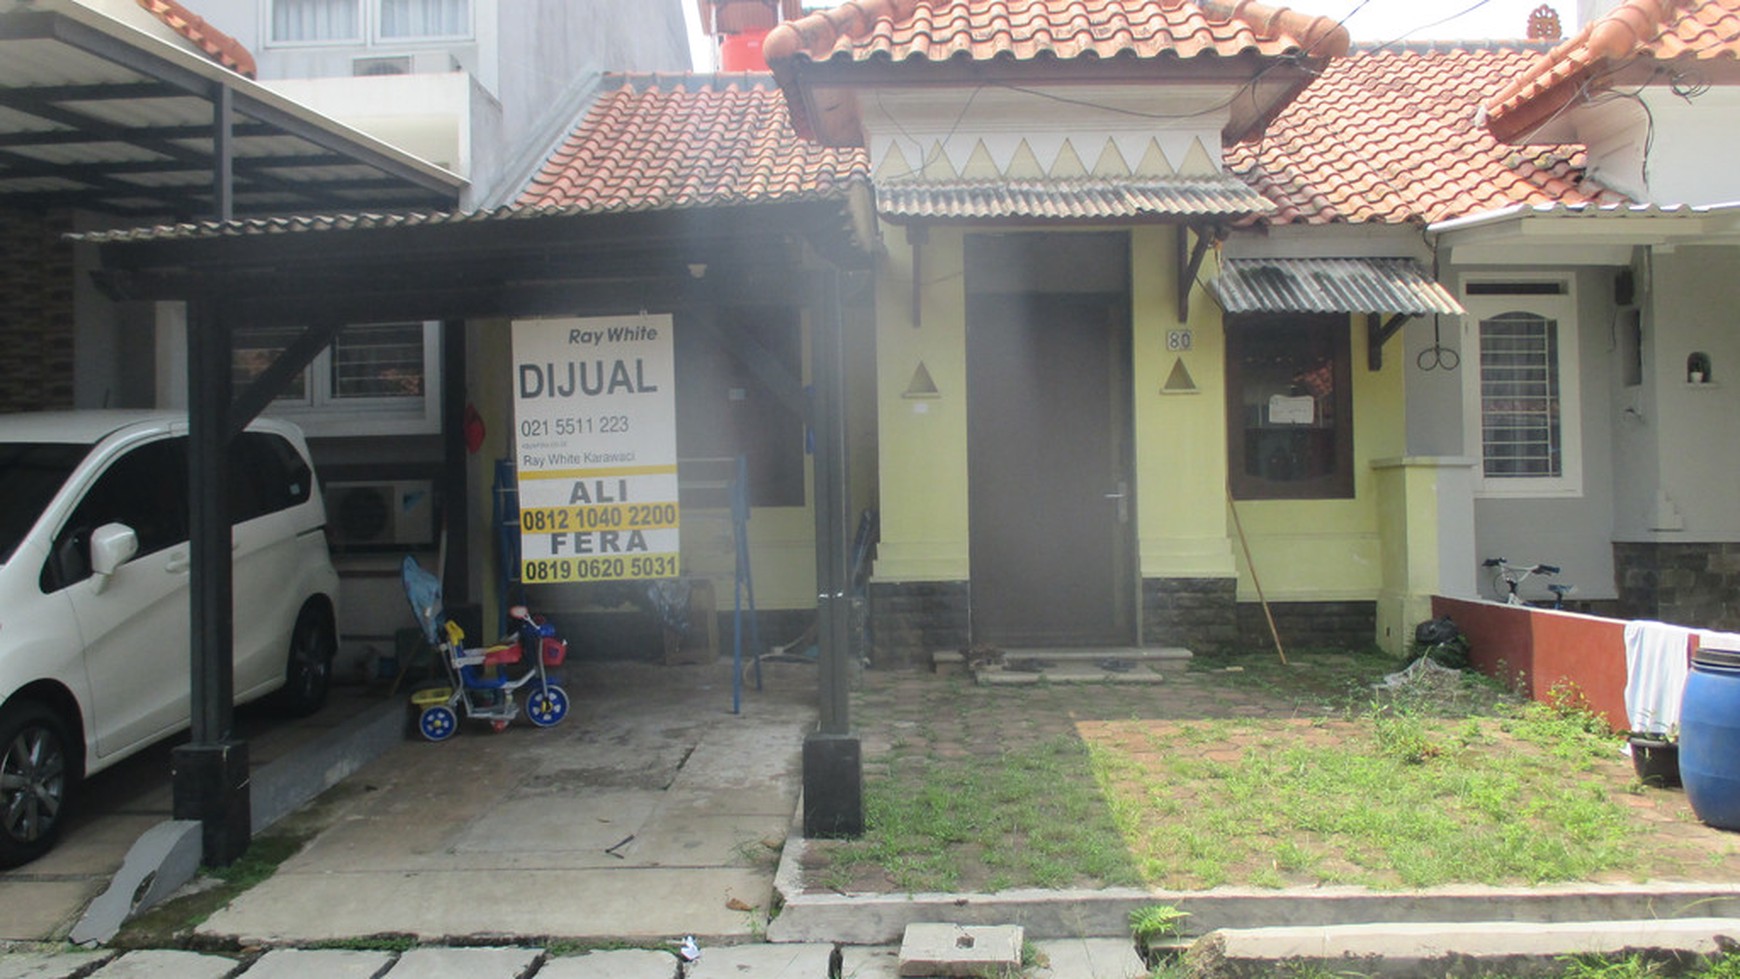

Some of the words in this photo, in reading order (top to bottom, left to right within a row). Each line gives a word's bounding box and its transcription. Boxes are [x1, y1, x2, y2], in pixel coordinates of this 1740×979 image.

[569, 328, 603, 346] Ray
[607, 325, 658, 342] White
[1169, 331, 1191, 348] 80
[519, 358, 658, 399] DIJUAL
[521, 420, 549, 437] 021
[555, 417, 593, 435] 5511
[599, 415, 629, 432] 223
[523, 455, 545, 468] Ray
[549, 453, 581, 465] White
[584, 451, 635, 463] Karawaci
[569, 479, 627, 505] ALI
[523, 509, 569, 531] 0812
[576, 507, 622, 528] 1040
[628, 504, 676, 526] 2200
[551, 529, 648, 555] FERA
[526, 560, 571, 580] 0819
[577, 558, 624, 578] 0620
[631, 556, 676, 576] 5031
